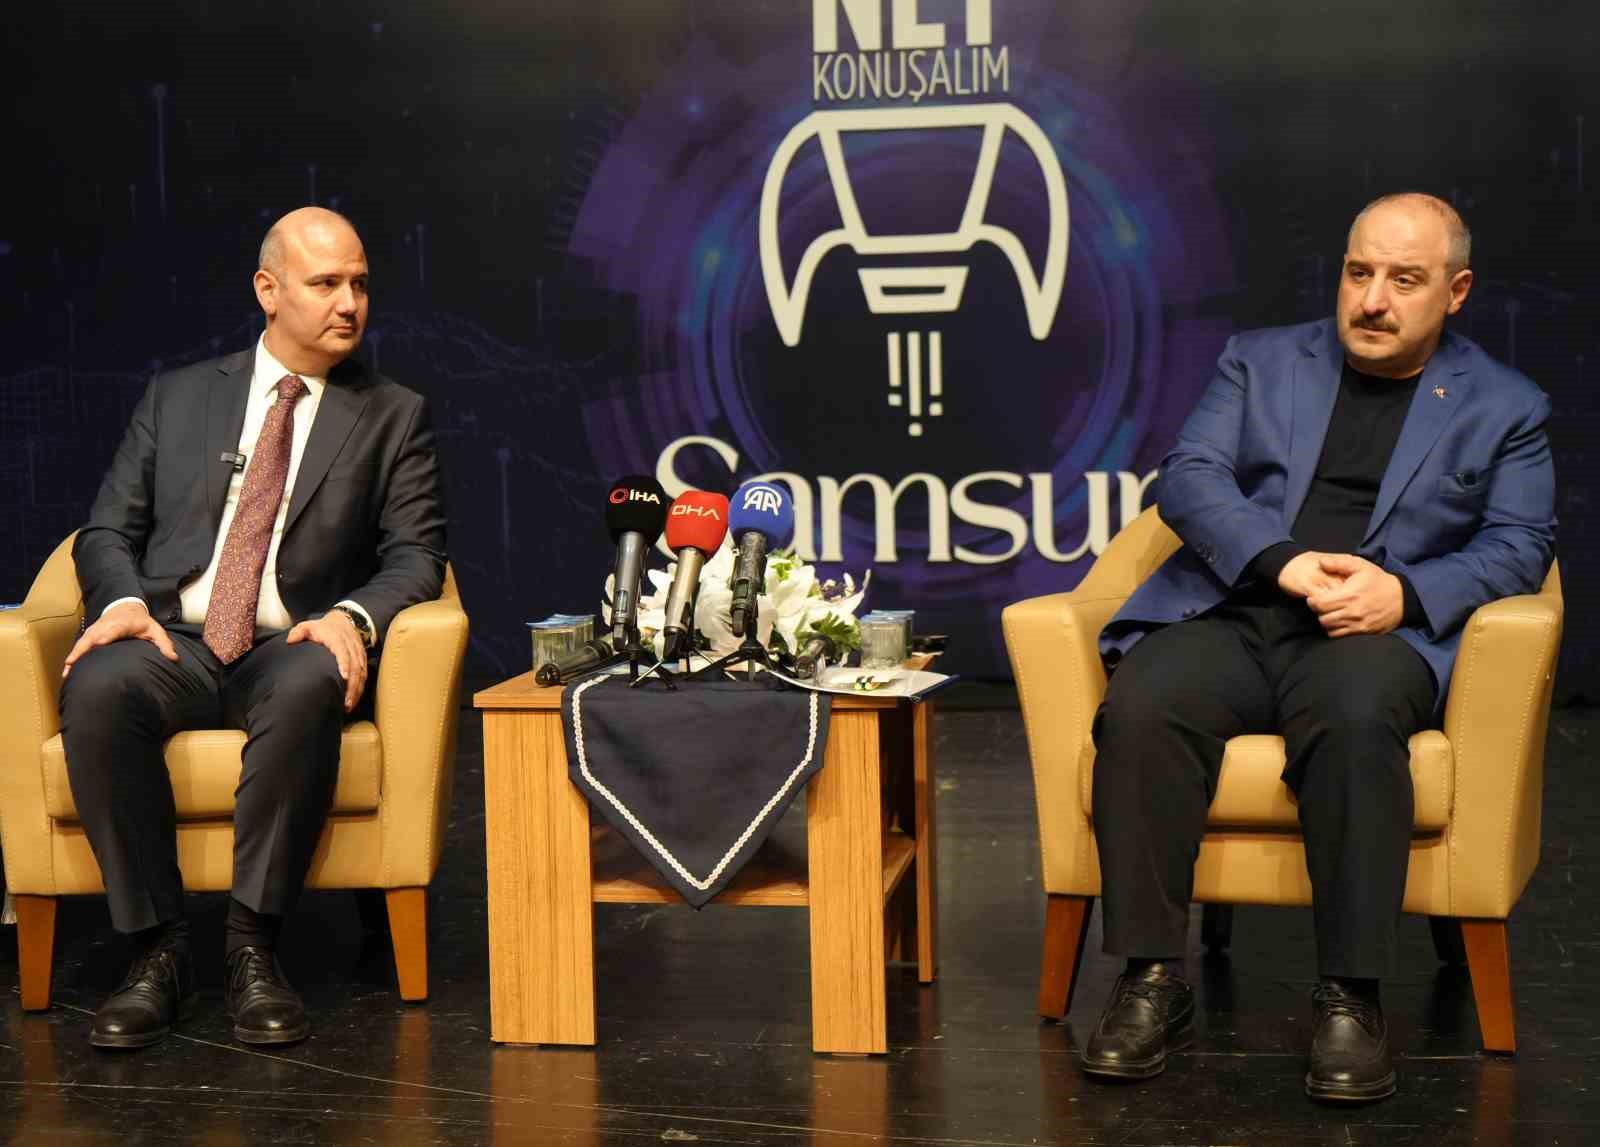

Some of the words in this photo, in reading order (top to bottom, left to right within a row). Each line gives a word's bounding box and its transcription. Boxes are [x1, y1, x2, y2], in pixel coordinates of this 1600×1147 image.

[813, 46, 1009, 102] KONUŞALIM
[672, 504, 720, 521] DHA
[742, 486, 783, 517] AA
